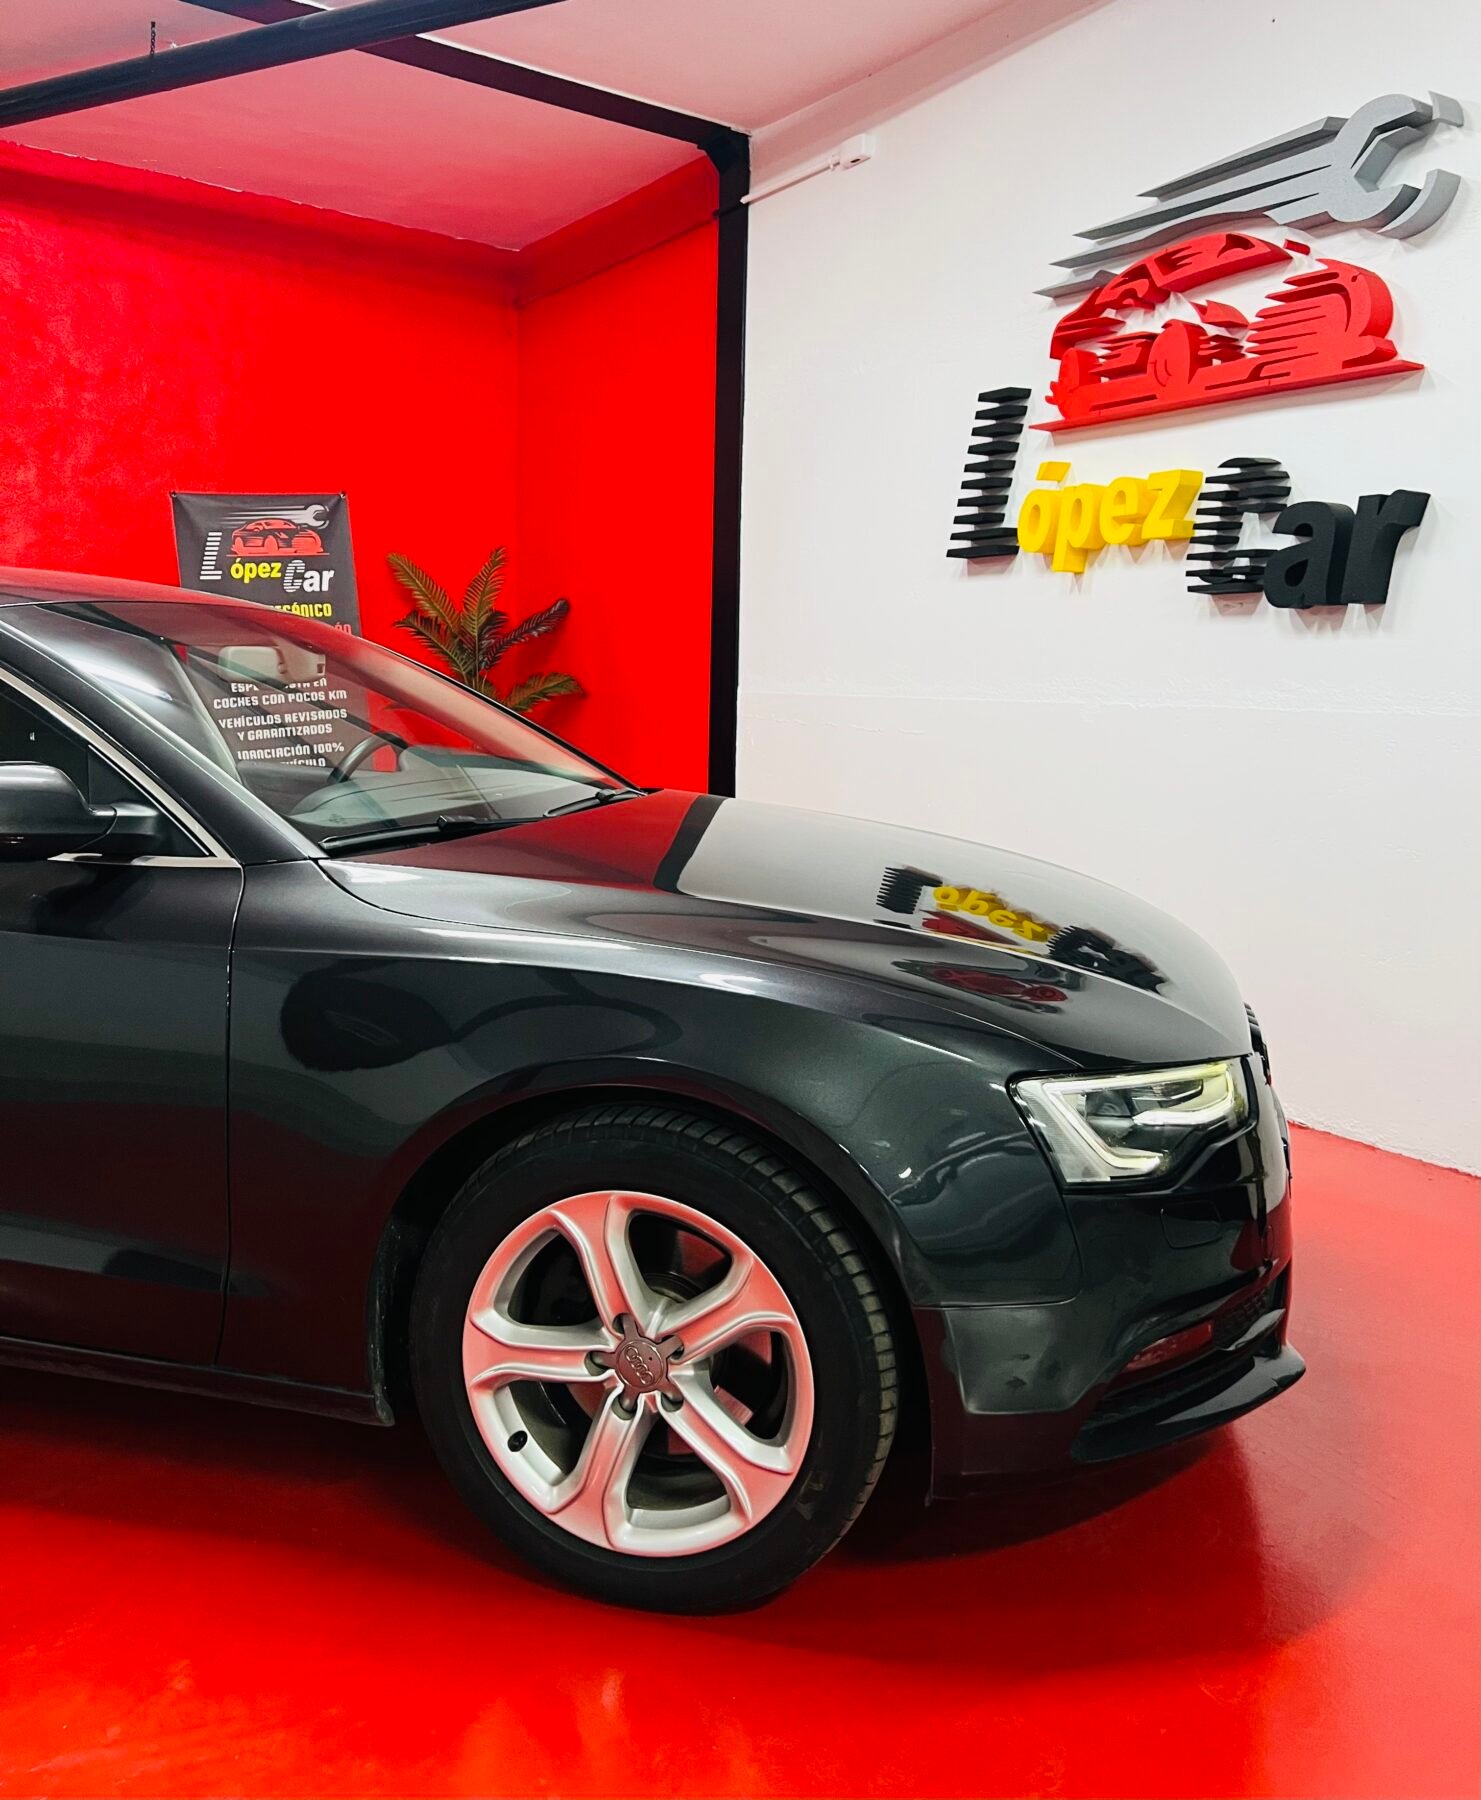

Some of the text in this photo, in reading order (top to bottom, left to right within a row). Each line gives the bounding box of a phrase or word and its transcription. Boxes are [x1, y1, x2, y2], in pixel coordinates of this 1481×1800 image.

[946, 387, 1431, 609] López Car
[200, 532, 335, 593] López Car
[213, 695, 259, 709] COCHES
[262, 693, 285, 706] CON
[289, 691, 325, 703] POCOS
[218, 708, 347, 729] VEHÍCULOS REVISADOS
[237, 723, 333, 741] Y GARANTIZADOS
[237, 742, 344, 760] INANCIACIÓN 100%
